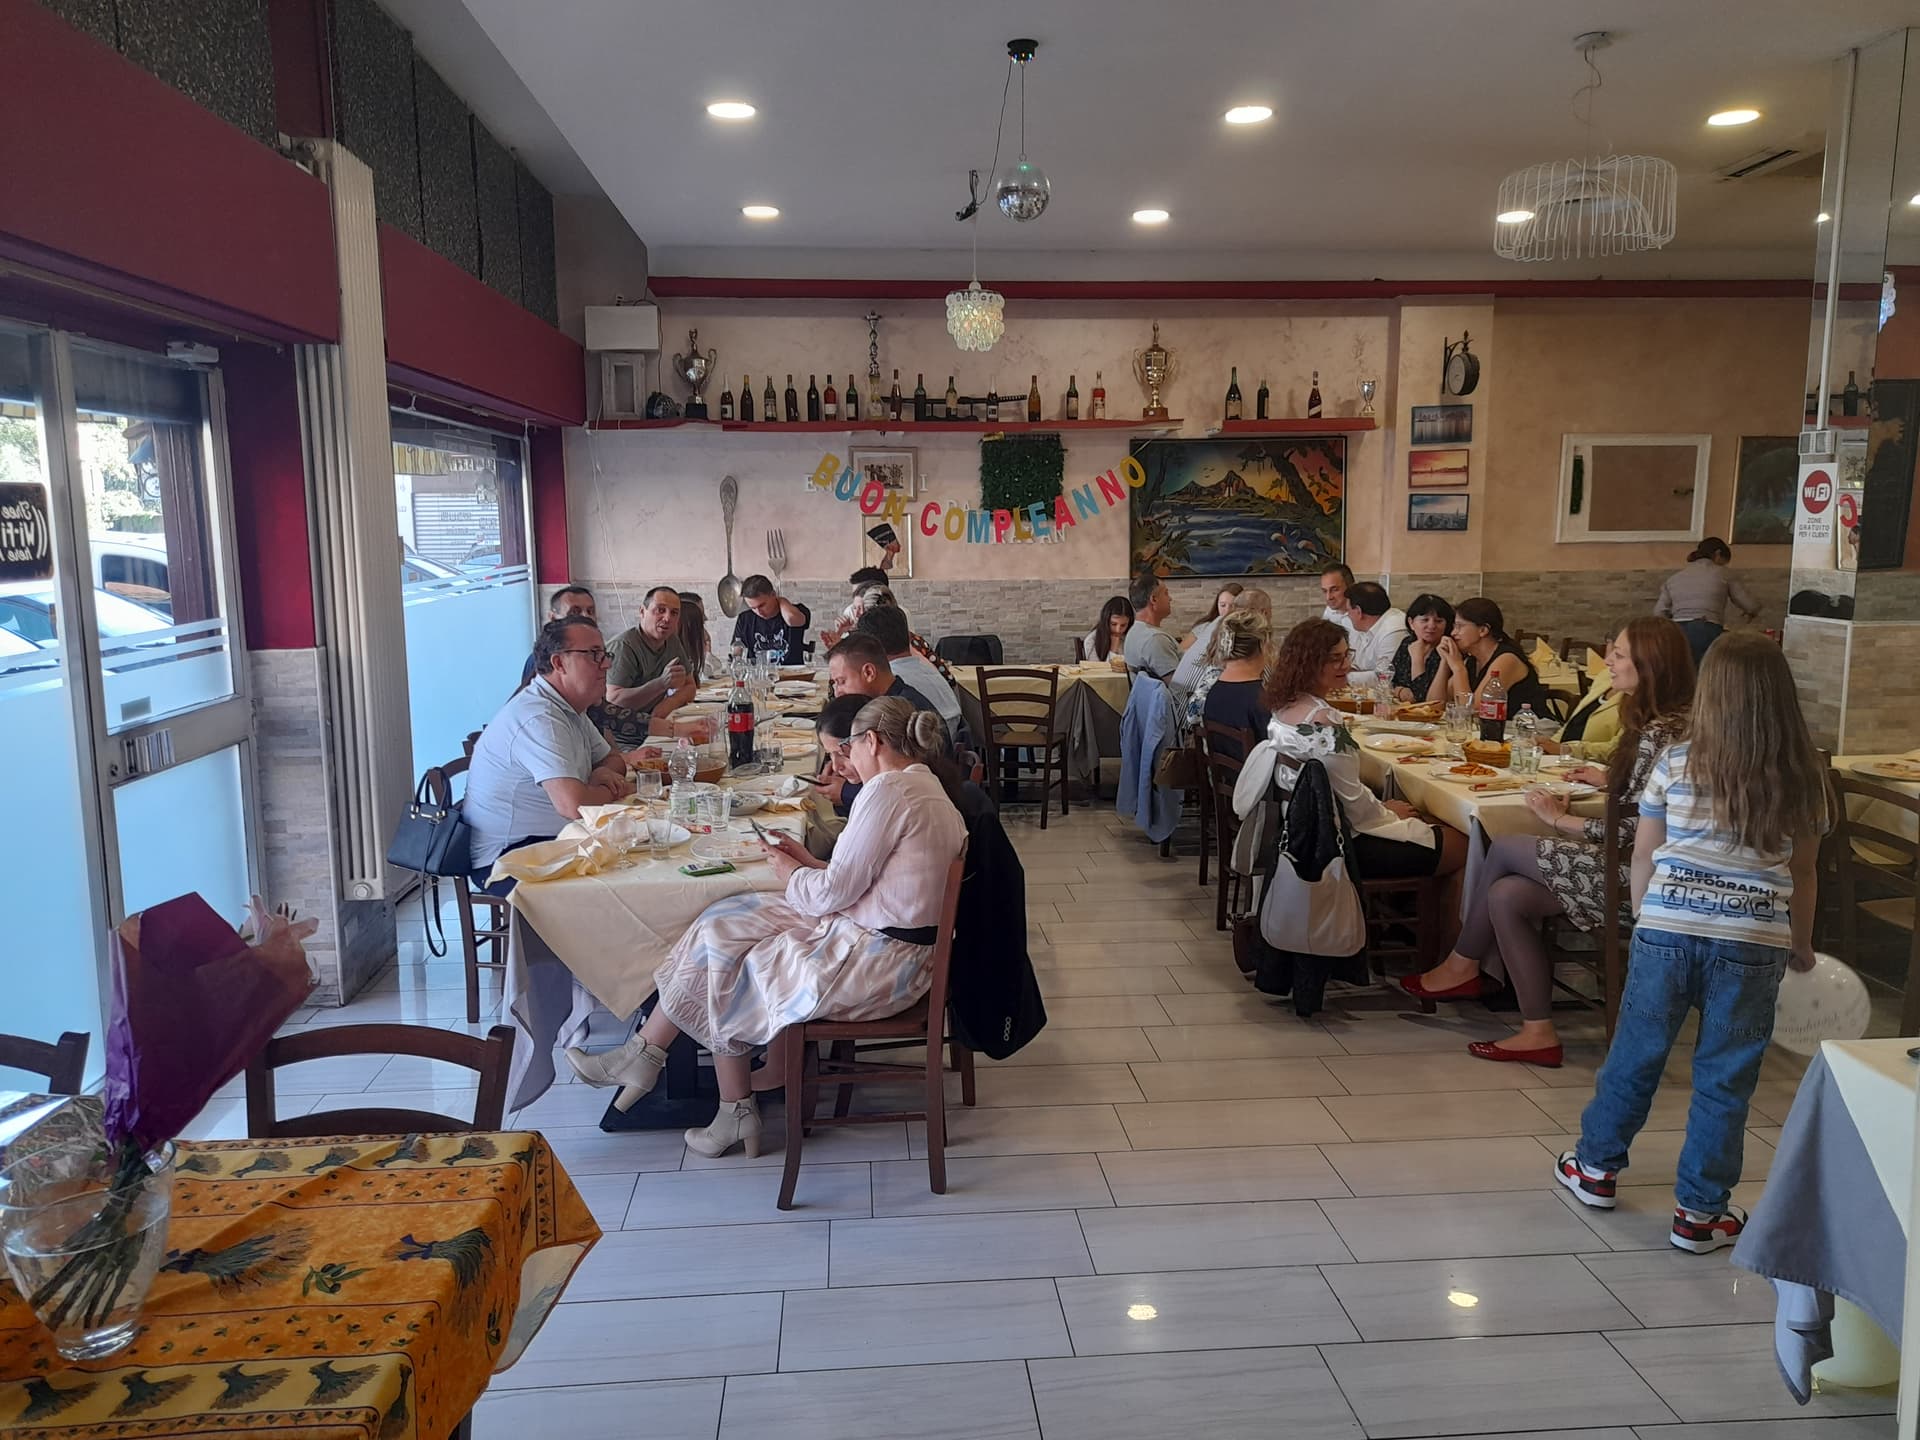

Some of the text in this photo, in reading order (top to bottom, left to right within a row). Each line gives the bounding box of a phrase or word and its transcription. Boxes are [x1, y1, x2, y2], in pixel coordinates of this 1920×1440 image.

[812, 452, 1147, 544] BUON COMPLEANNO
[1669, 865, 1721, 880] STREET
